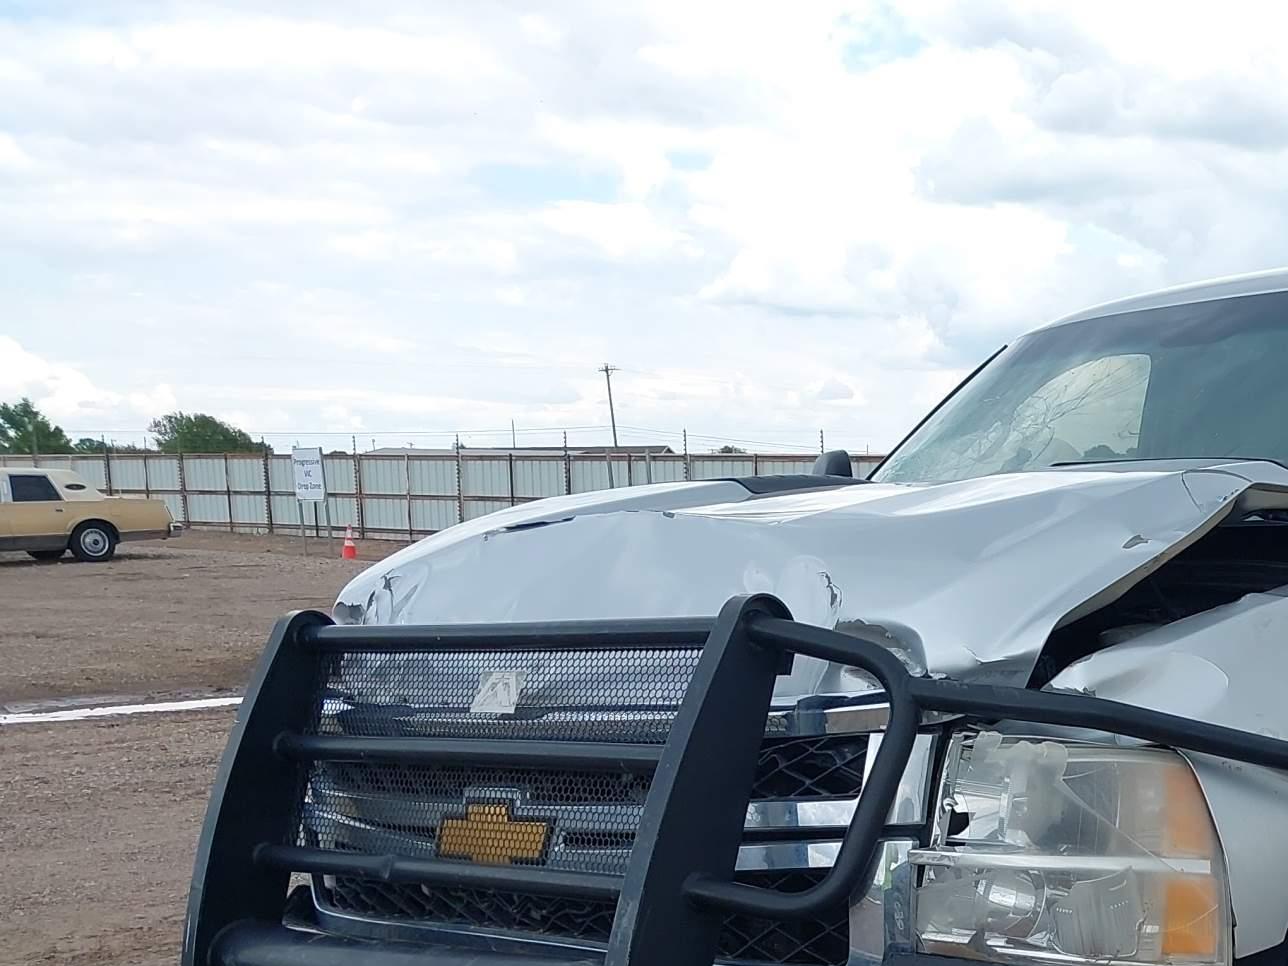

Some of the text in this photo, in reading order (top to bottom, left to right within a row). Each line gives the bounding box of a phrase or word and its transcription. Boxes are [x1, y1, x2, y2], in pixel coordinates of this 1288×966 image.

[293, 458, 320, 467] Progressive
[297, 482, 322, 491] Drop Zone
